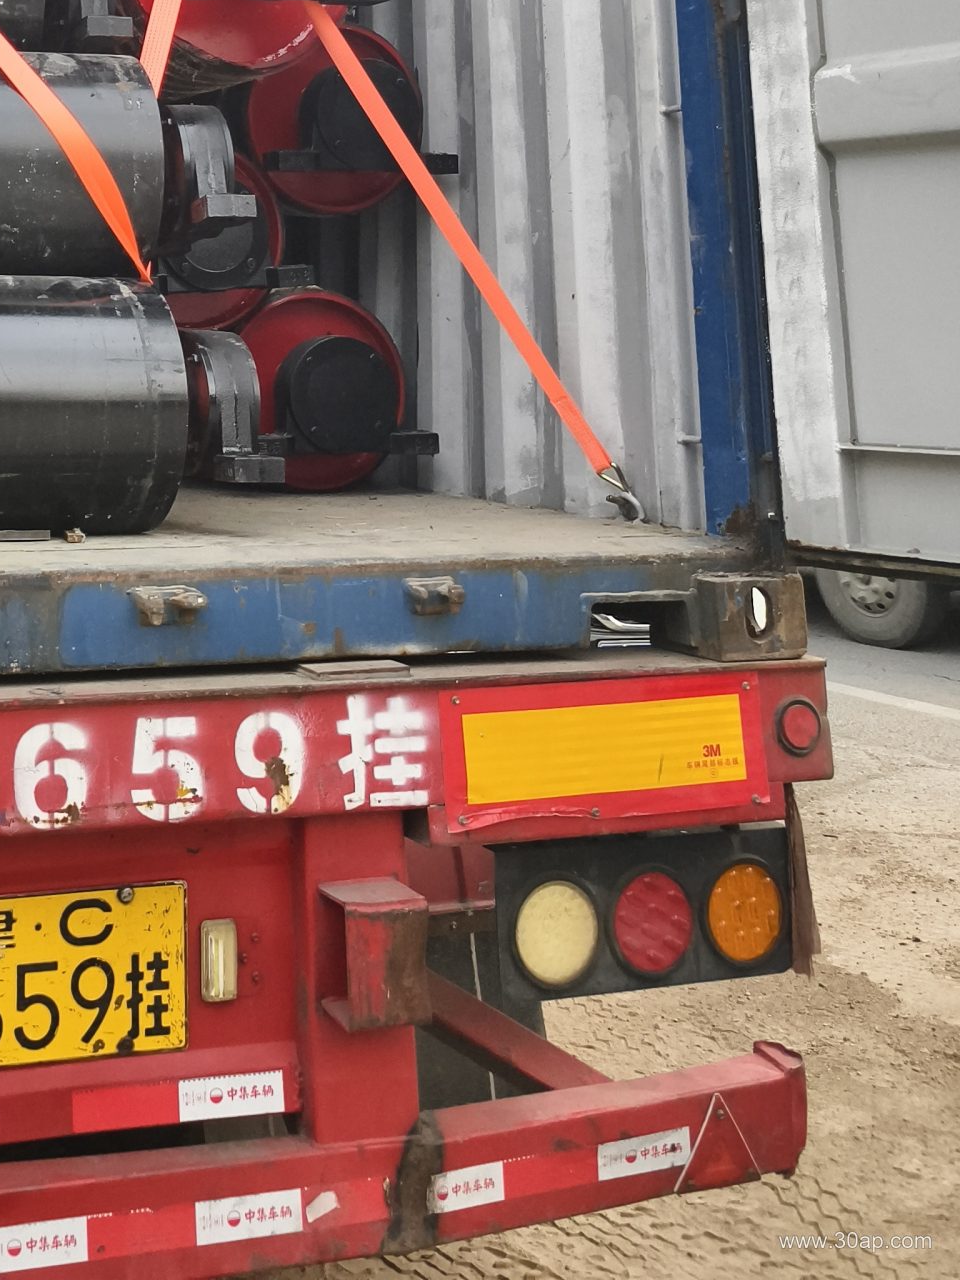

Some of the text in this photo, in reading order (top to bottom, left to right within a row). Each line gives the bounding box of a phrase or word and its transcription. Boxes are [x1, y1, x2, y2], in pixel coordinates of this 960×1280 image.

[702, 743, 722, 758] 3M
[226, 1084, 275, 1102] 中集车辆
[451, 1177, 495, 1197] 中集车辆
[244, 1205, 293, 1224] 中集车辆
[25, 1233, 77, 1254] 中集车辆
